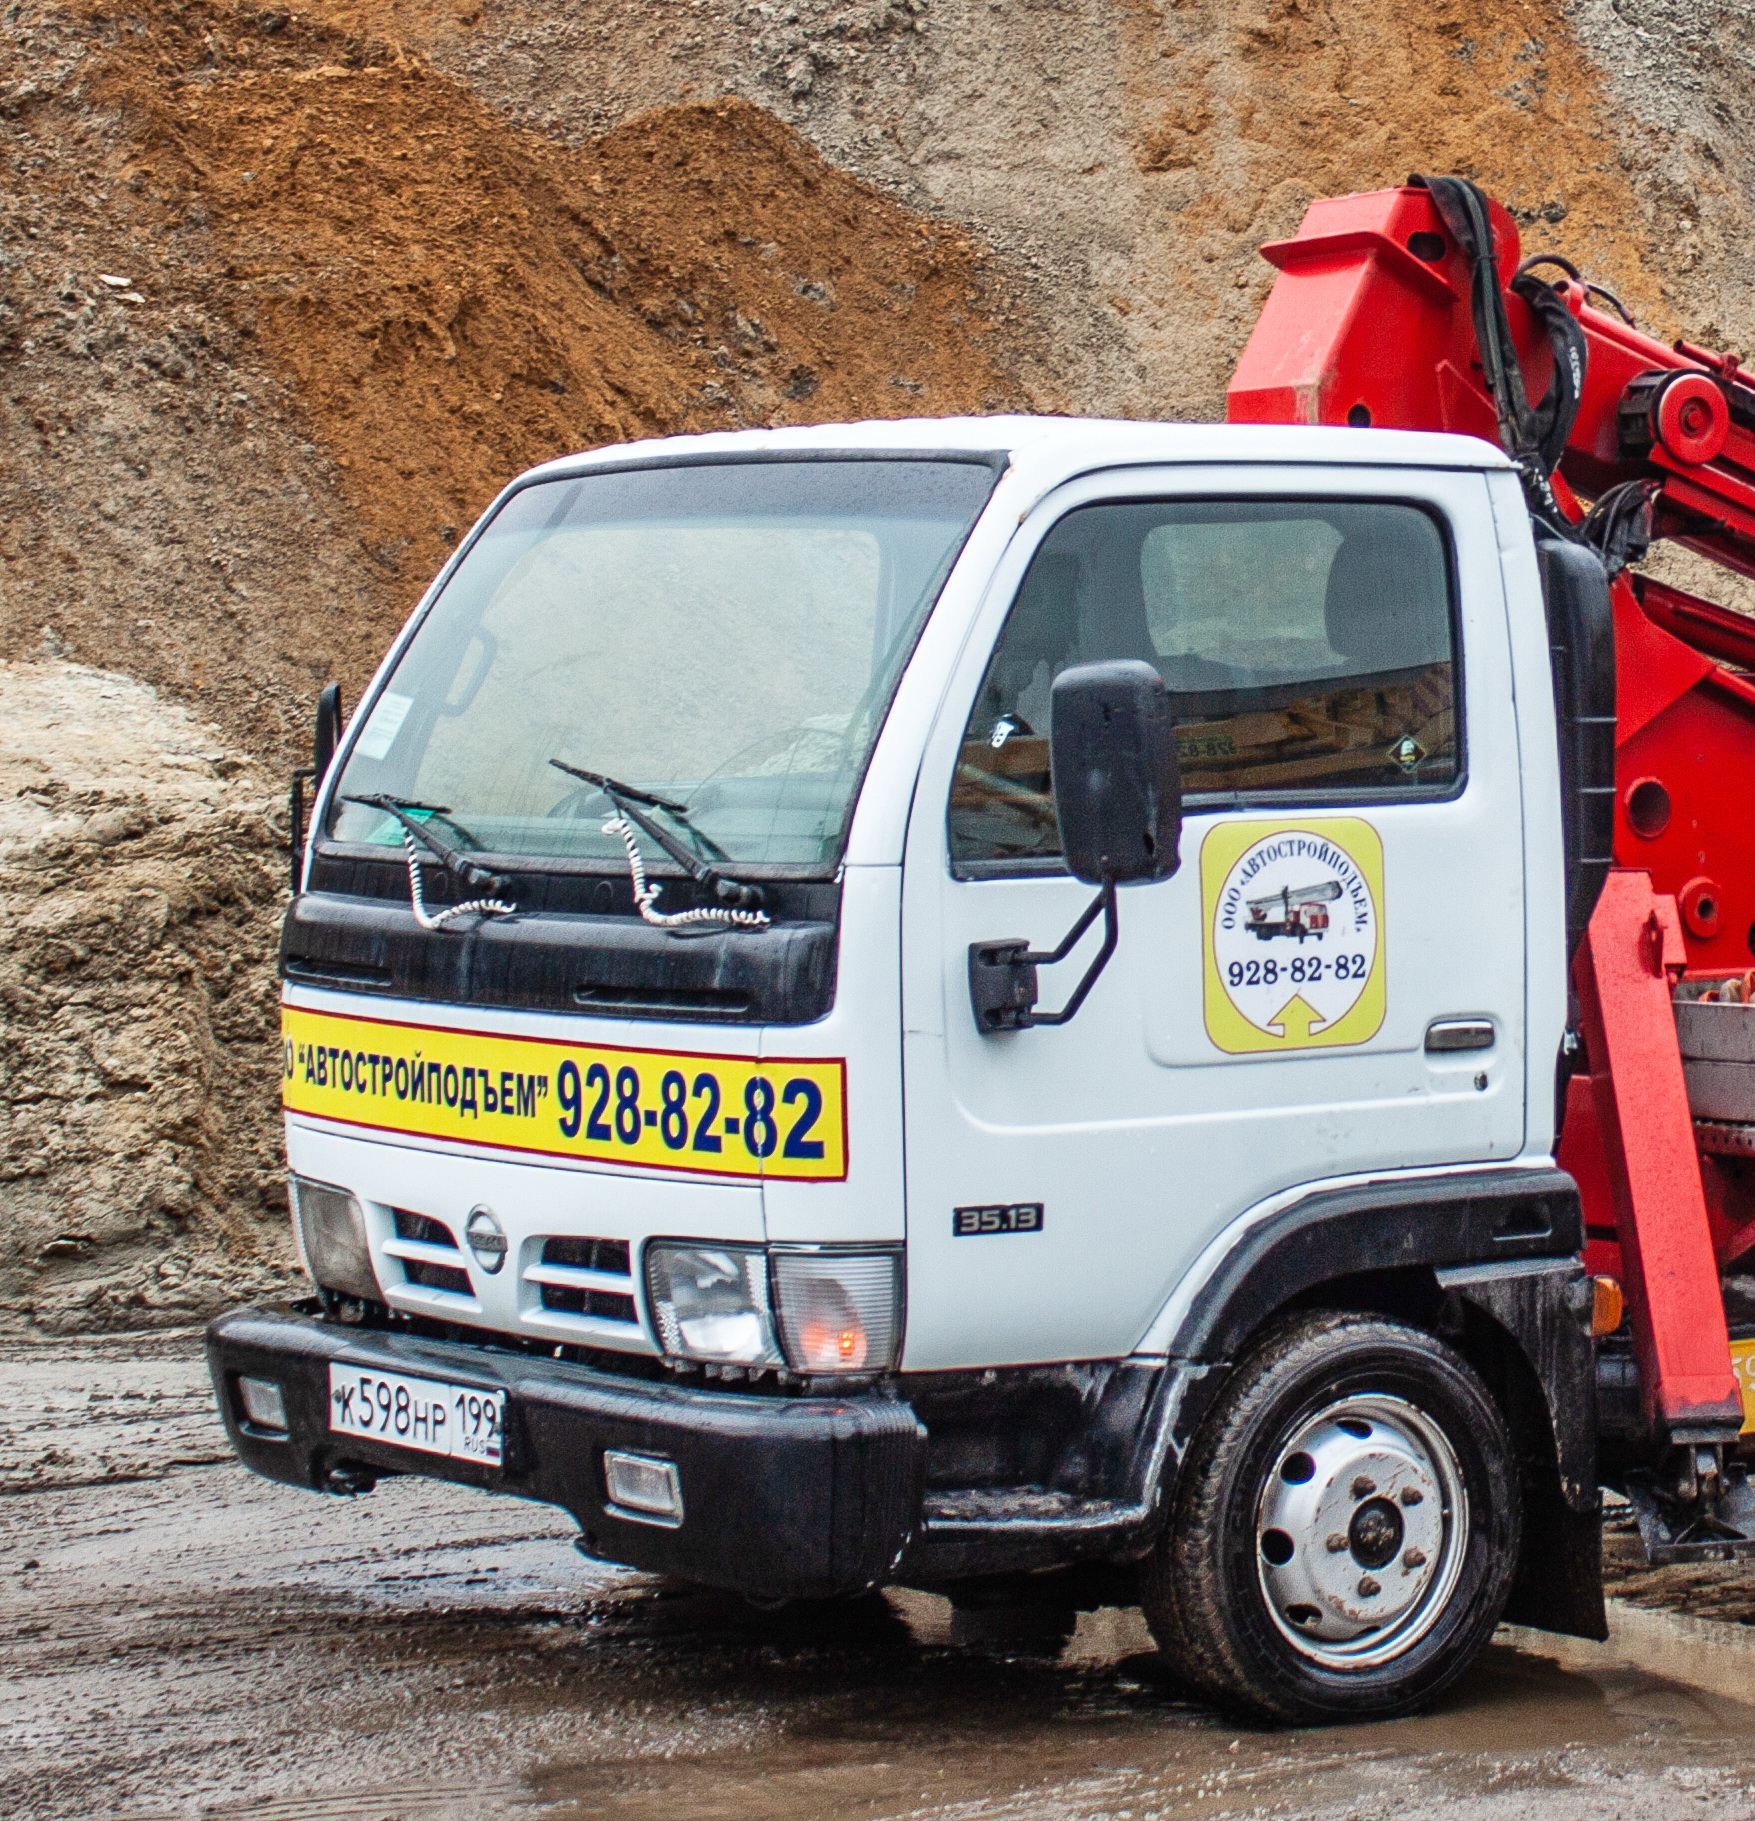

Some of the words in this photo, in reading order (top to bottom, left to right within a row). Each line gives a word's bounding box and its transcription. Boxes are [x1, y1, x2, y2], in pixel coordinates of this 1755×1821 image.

[1222, 888, 1242, 930] ООО
[1228, 953, 1367, 987] 928-82-82
[557, 1059, 826, 1160] 928-82-82
[960, 1206, 1037, 1233] 35.13
[455, 1393, 498, 1438] 199
[464, 1436, 486, 1455] RUS
